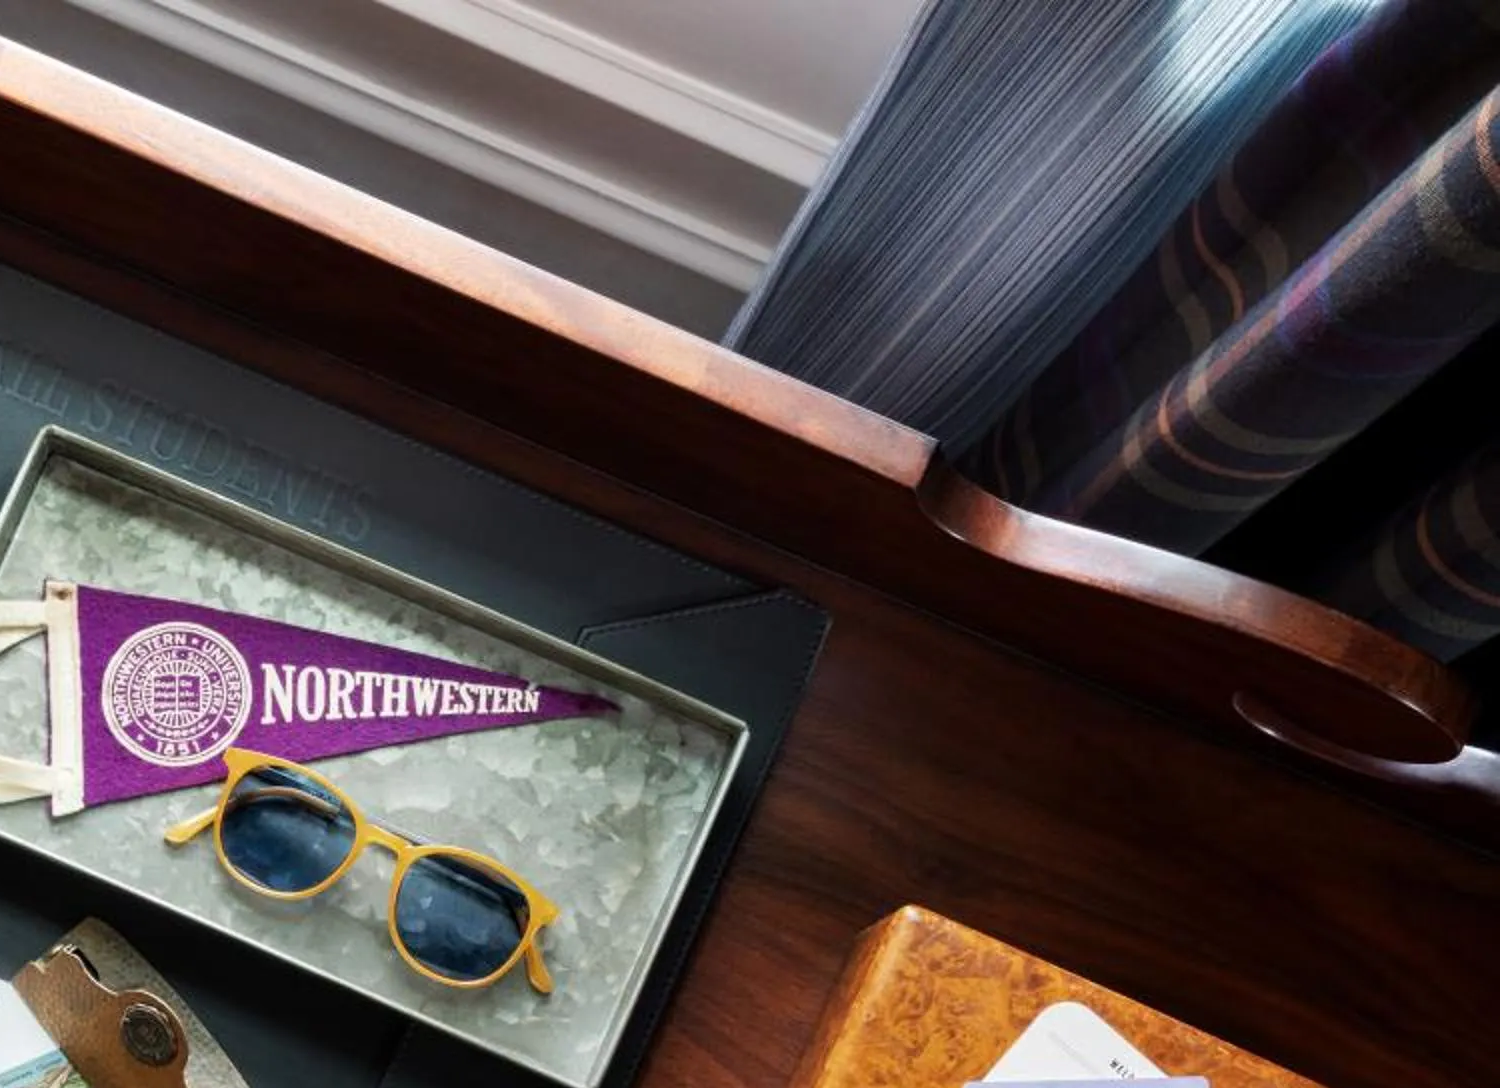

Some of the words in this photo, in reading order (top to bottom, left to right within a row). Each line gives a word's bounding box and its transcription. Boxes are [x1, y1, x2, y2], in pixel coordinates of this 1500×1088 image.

[113, 632, 188, 727] NORTHWESTERN
[202, 640, 242, 726] UNIVERSITY
[260, 662, 541, 725] NORTHWESTERN
